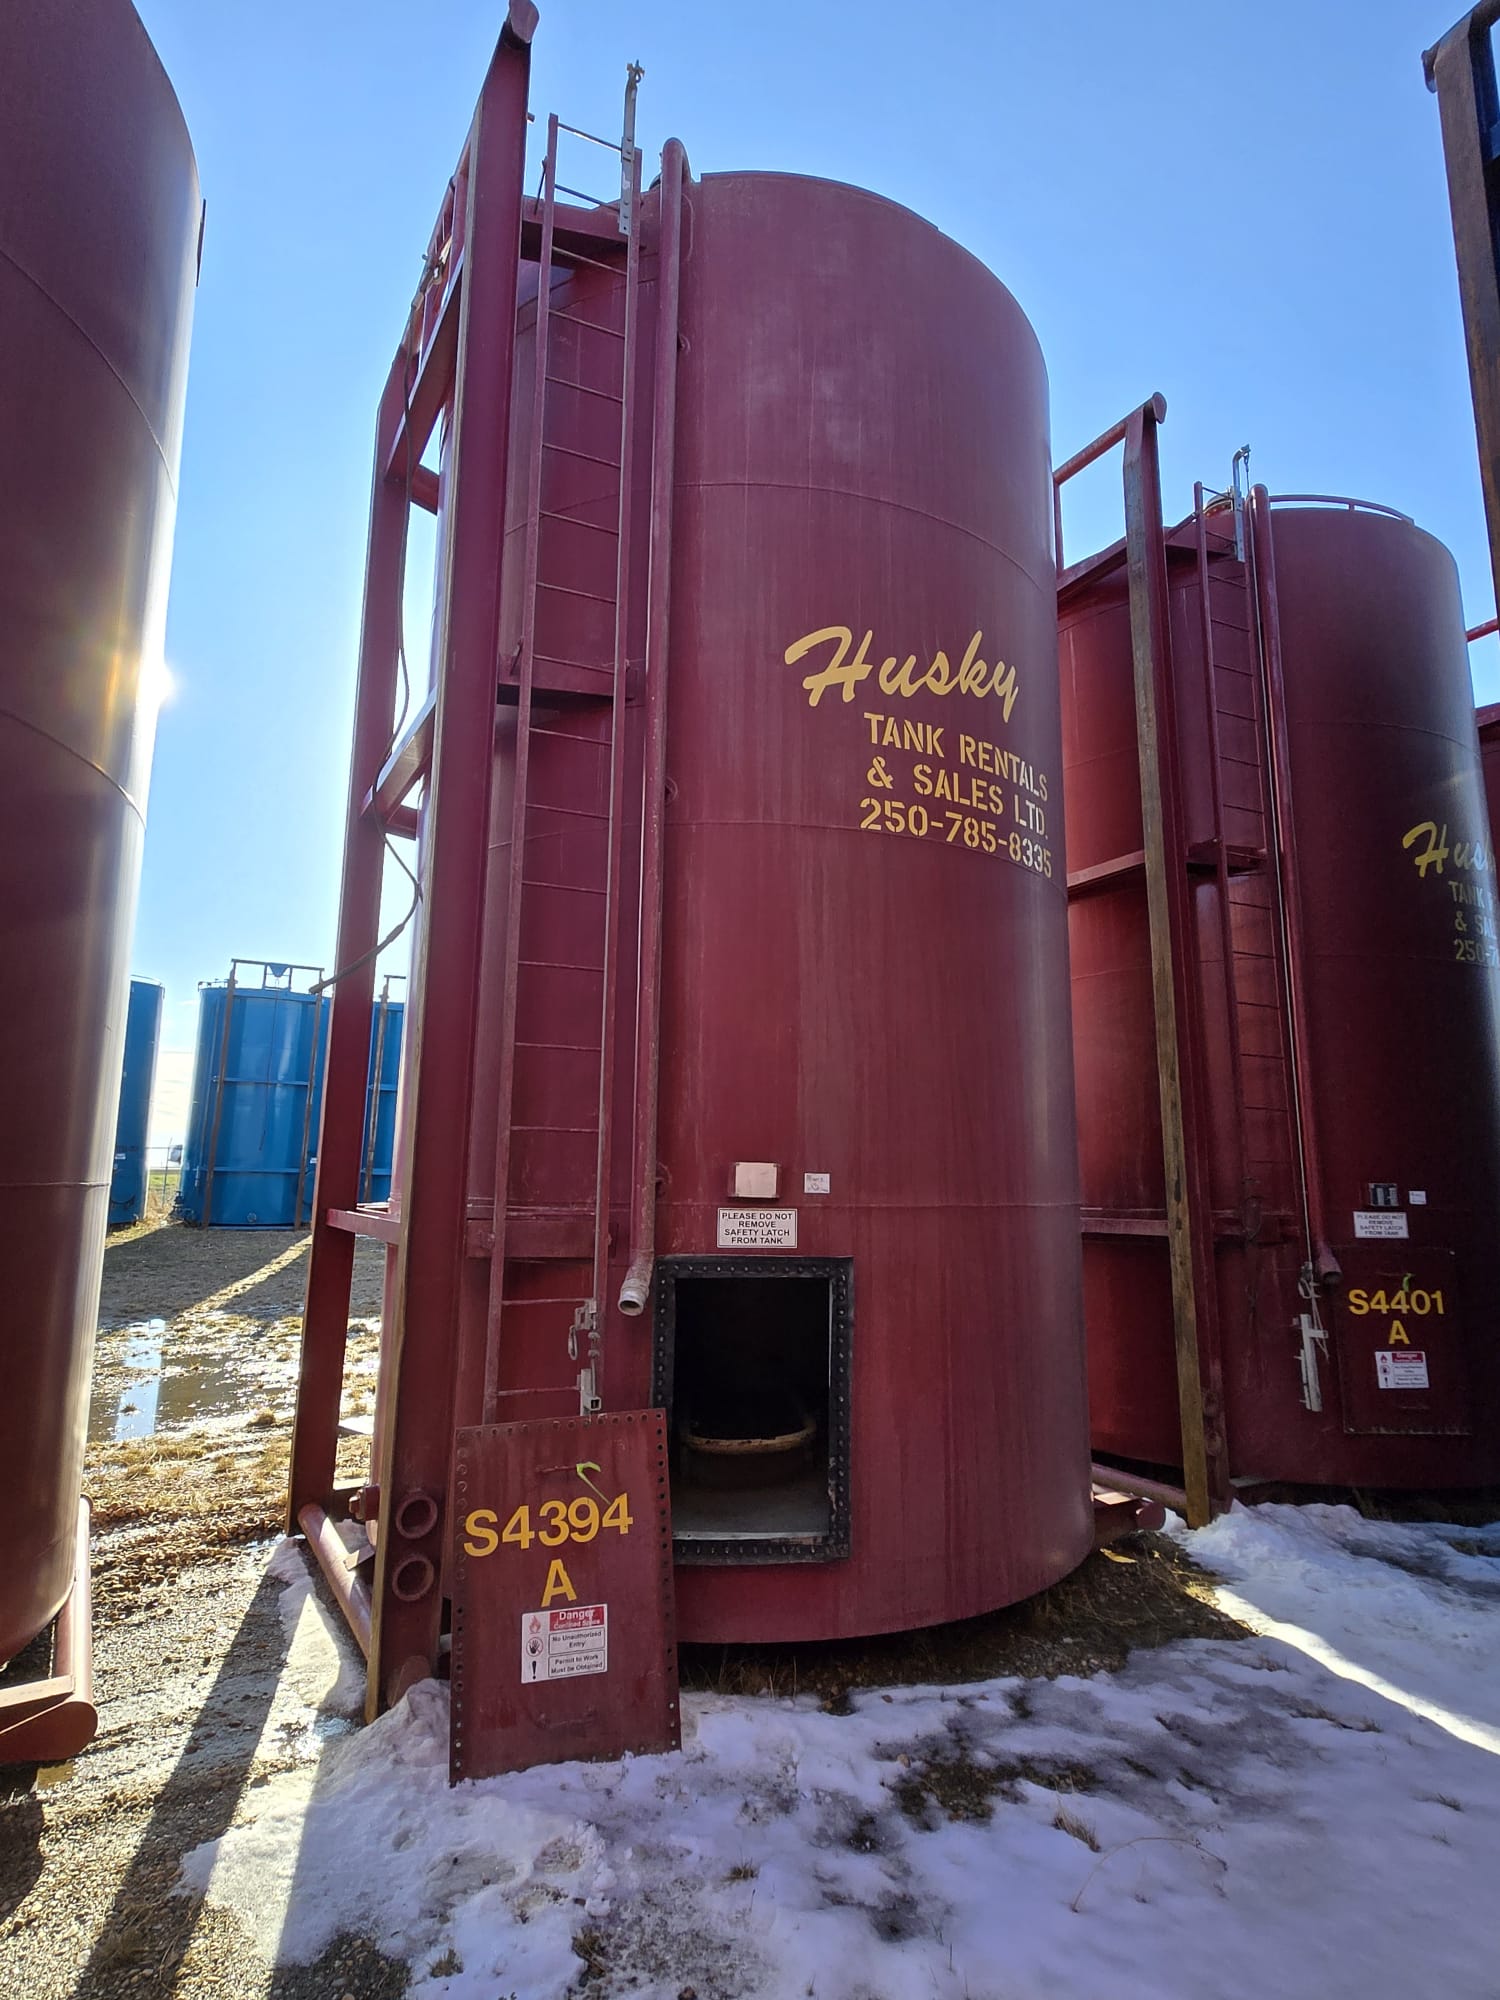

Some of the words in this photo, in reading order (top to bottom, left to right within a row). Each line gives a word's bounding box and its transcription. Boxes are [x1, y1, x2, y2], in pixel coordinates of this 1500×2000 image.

[785, 626, 1019, 723] Husky
[864, 712, 945, 758] TANK
[959, 734, 1048, 802] RENTALS
[867, 756, 893, 789] &
[913, 764, 1004, 815] SALES
[1014, 794, 1048, 840] LTD.
[859, 797, 1052, 878] 250-785-8335
[1454, 911, 1467, 932] &
[1348, 1289, 1444, 1315] S4401
[1388, 1320, 1410, 1345] A
[463, 1492, 633, 1557] S4394
[541, 1559, 577, 1607] A
[560, 1609, 595, 1621] Danger
[569, 1641, 585, 1649] Entry
